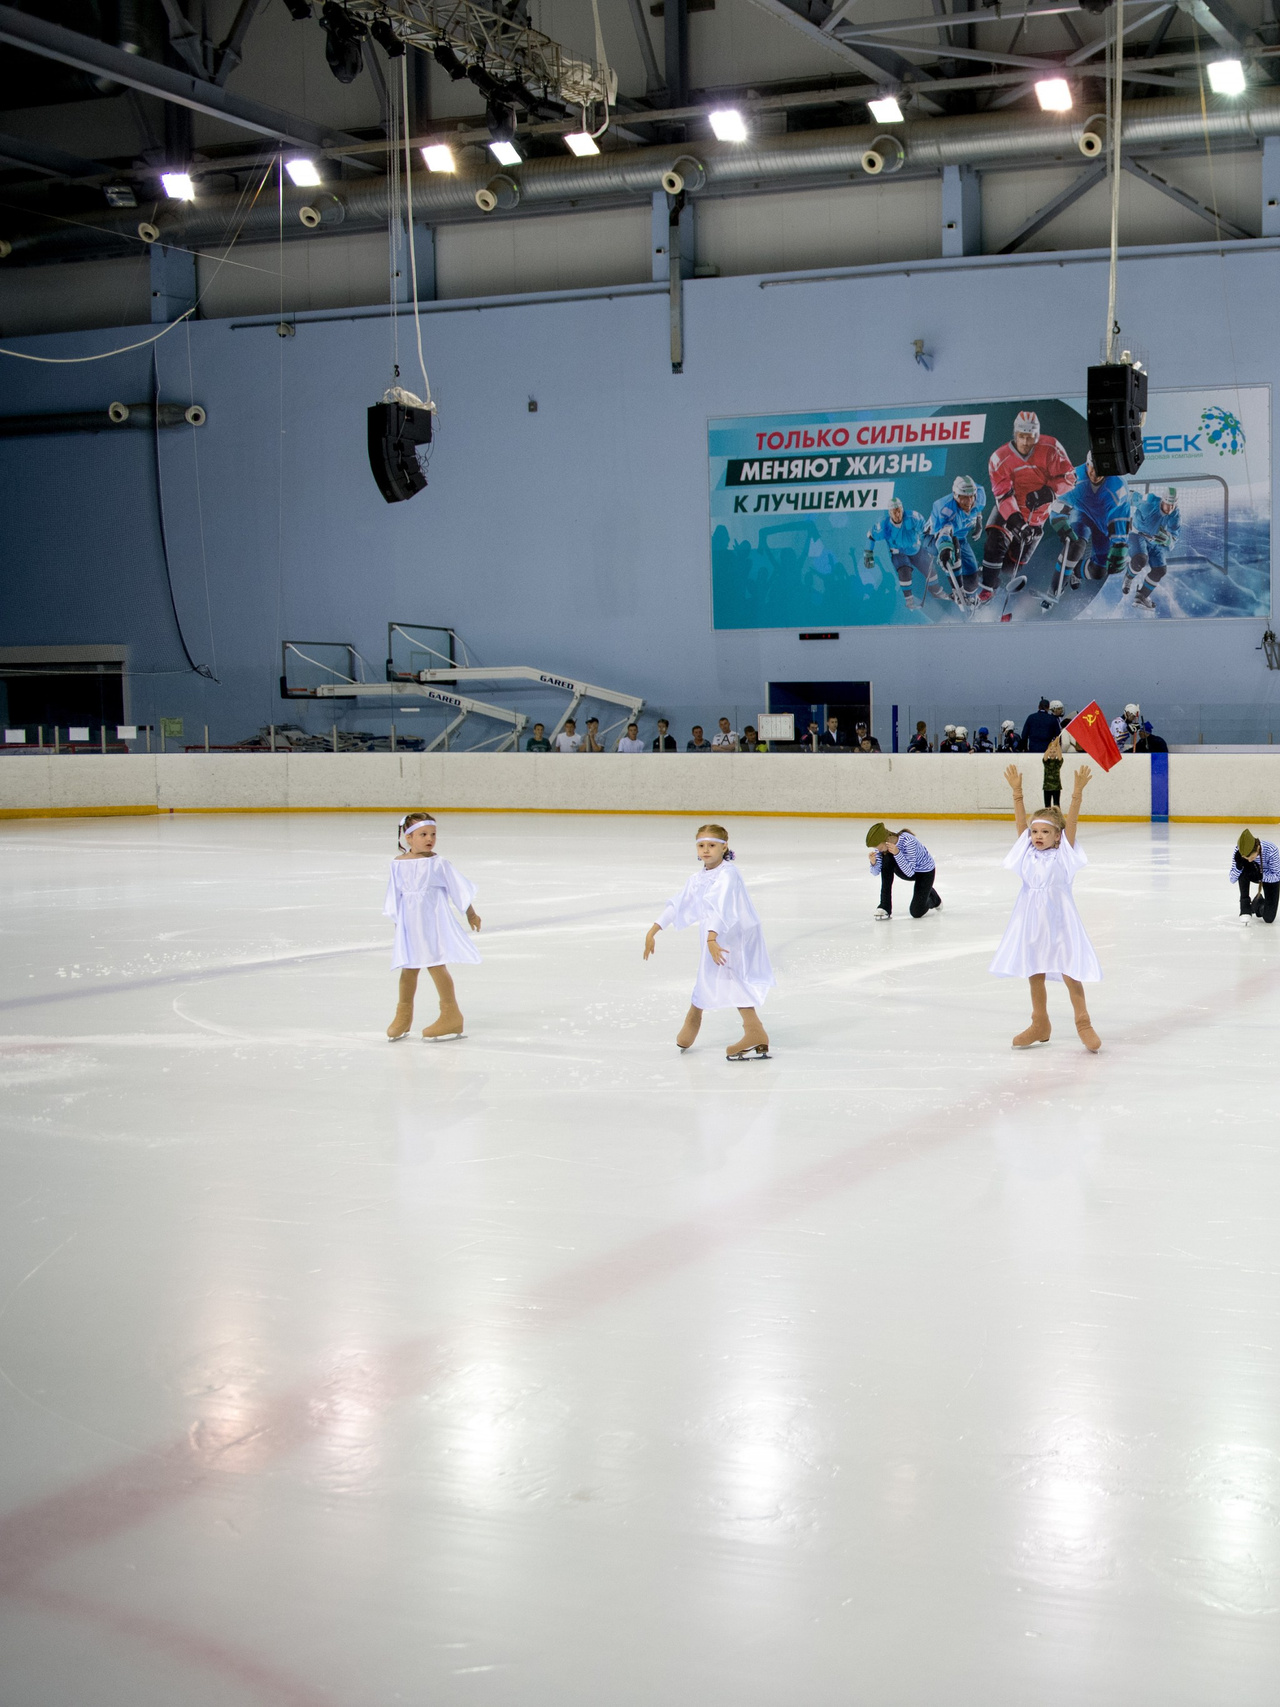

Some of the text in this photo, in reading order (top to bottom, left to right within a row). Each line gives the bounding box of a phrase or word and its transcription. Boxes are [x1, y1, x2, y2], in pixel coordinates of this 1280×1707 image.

[756, 421, 971, 450] ТОЛЬКО СИЛЬНЫЕ
[740, 452, 933, 482] МЕНЯЮТ ЖИЗНЬ
[733, 489, 878, 514] К ЛУЧШЕМУ!
[540, 674, 575, 690] GARED
[428, 691, 461, 706] GARED
